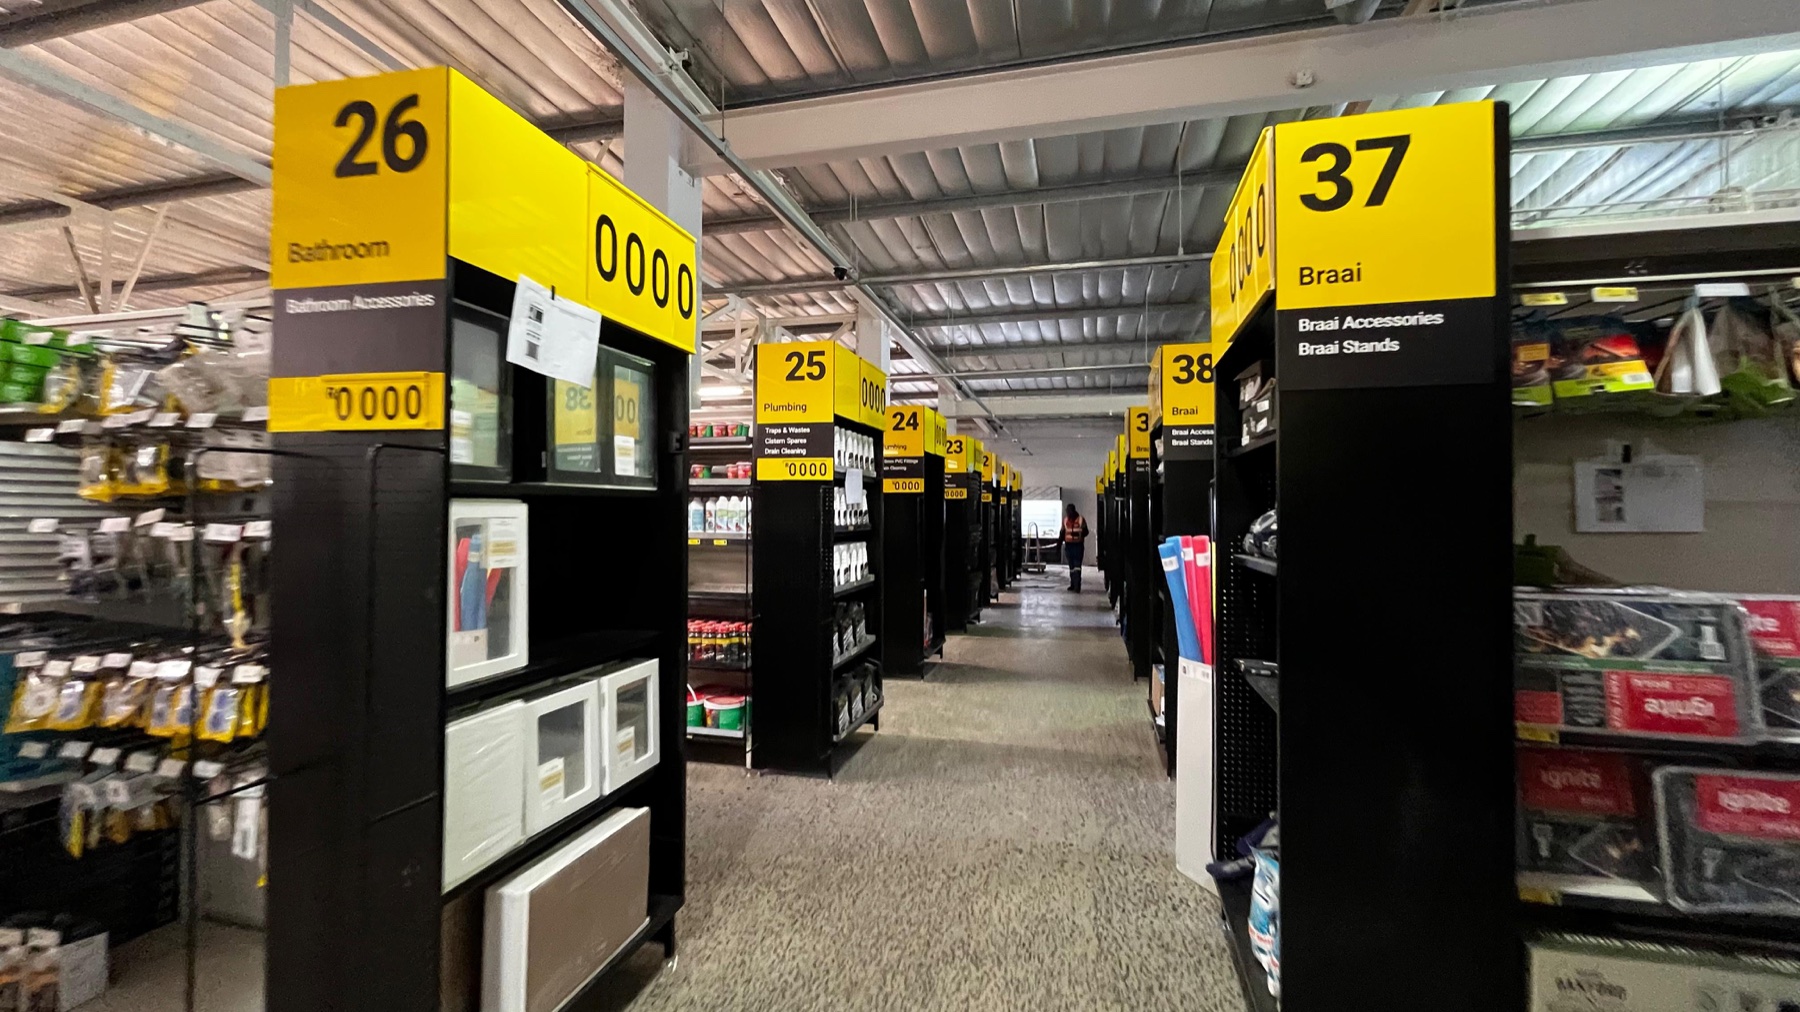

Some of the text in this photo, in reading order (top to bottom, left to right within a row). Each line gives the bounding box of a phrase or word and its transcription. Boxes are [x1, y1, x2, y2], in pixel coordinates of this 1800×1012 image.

[333, 93, 429, 178] 26
[1299, 133, 1412, 213] 37
[288, 239, 391, 263] Bathroom
[595, 213, 694, 320] 0000
[1299, 262, 1362, 286] Braai
[286, 291, 436, 314] Bathroom Accessories
[1298, 311, 1444, 332] Braai Accessories
[1298, 338, 1400, 356] Braai Stands
[785, 350, 826, 381] 25
[1172, 353, 1215, 385] 38
[763, 402, 807, 413] Plumbing
[1172, 405, 1198, 416] Braai
[765, 426, 811, 435] Traps & Wastes
[892, 411, 919, 431] 24
[1136, 412, 1149, 432] 3
[764, 437, 807, 445] Cistern Spares
[946, 439, 963, 455] 23
[1190, 438, 1214, 446] Stands
[764, 447, 807, 456] Drain Cleaning
[982, 455, 989, 467] 2
